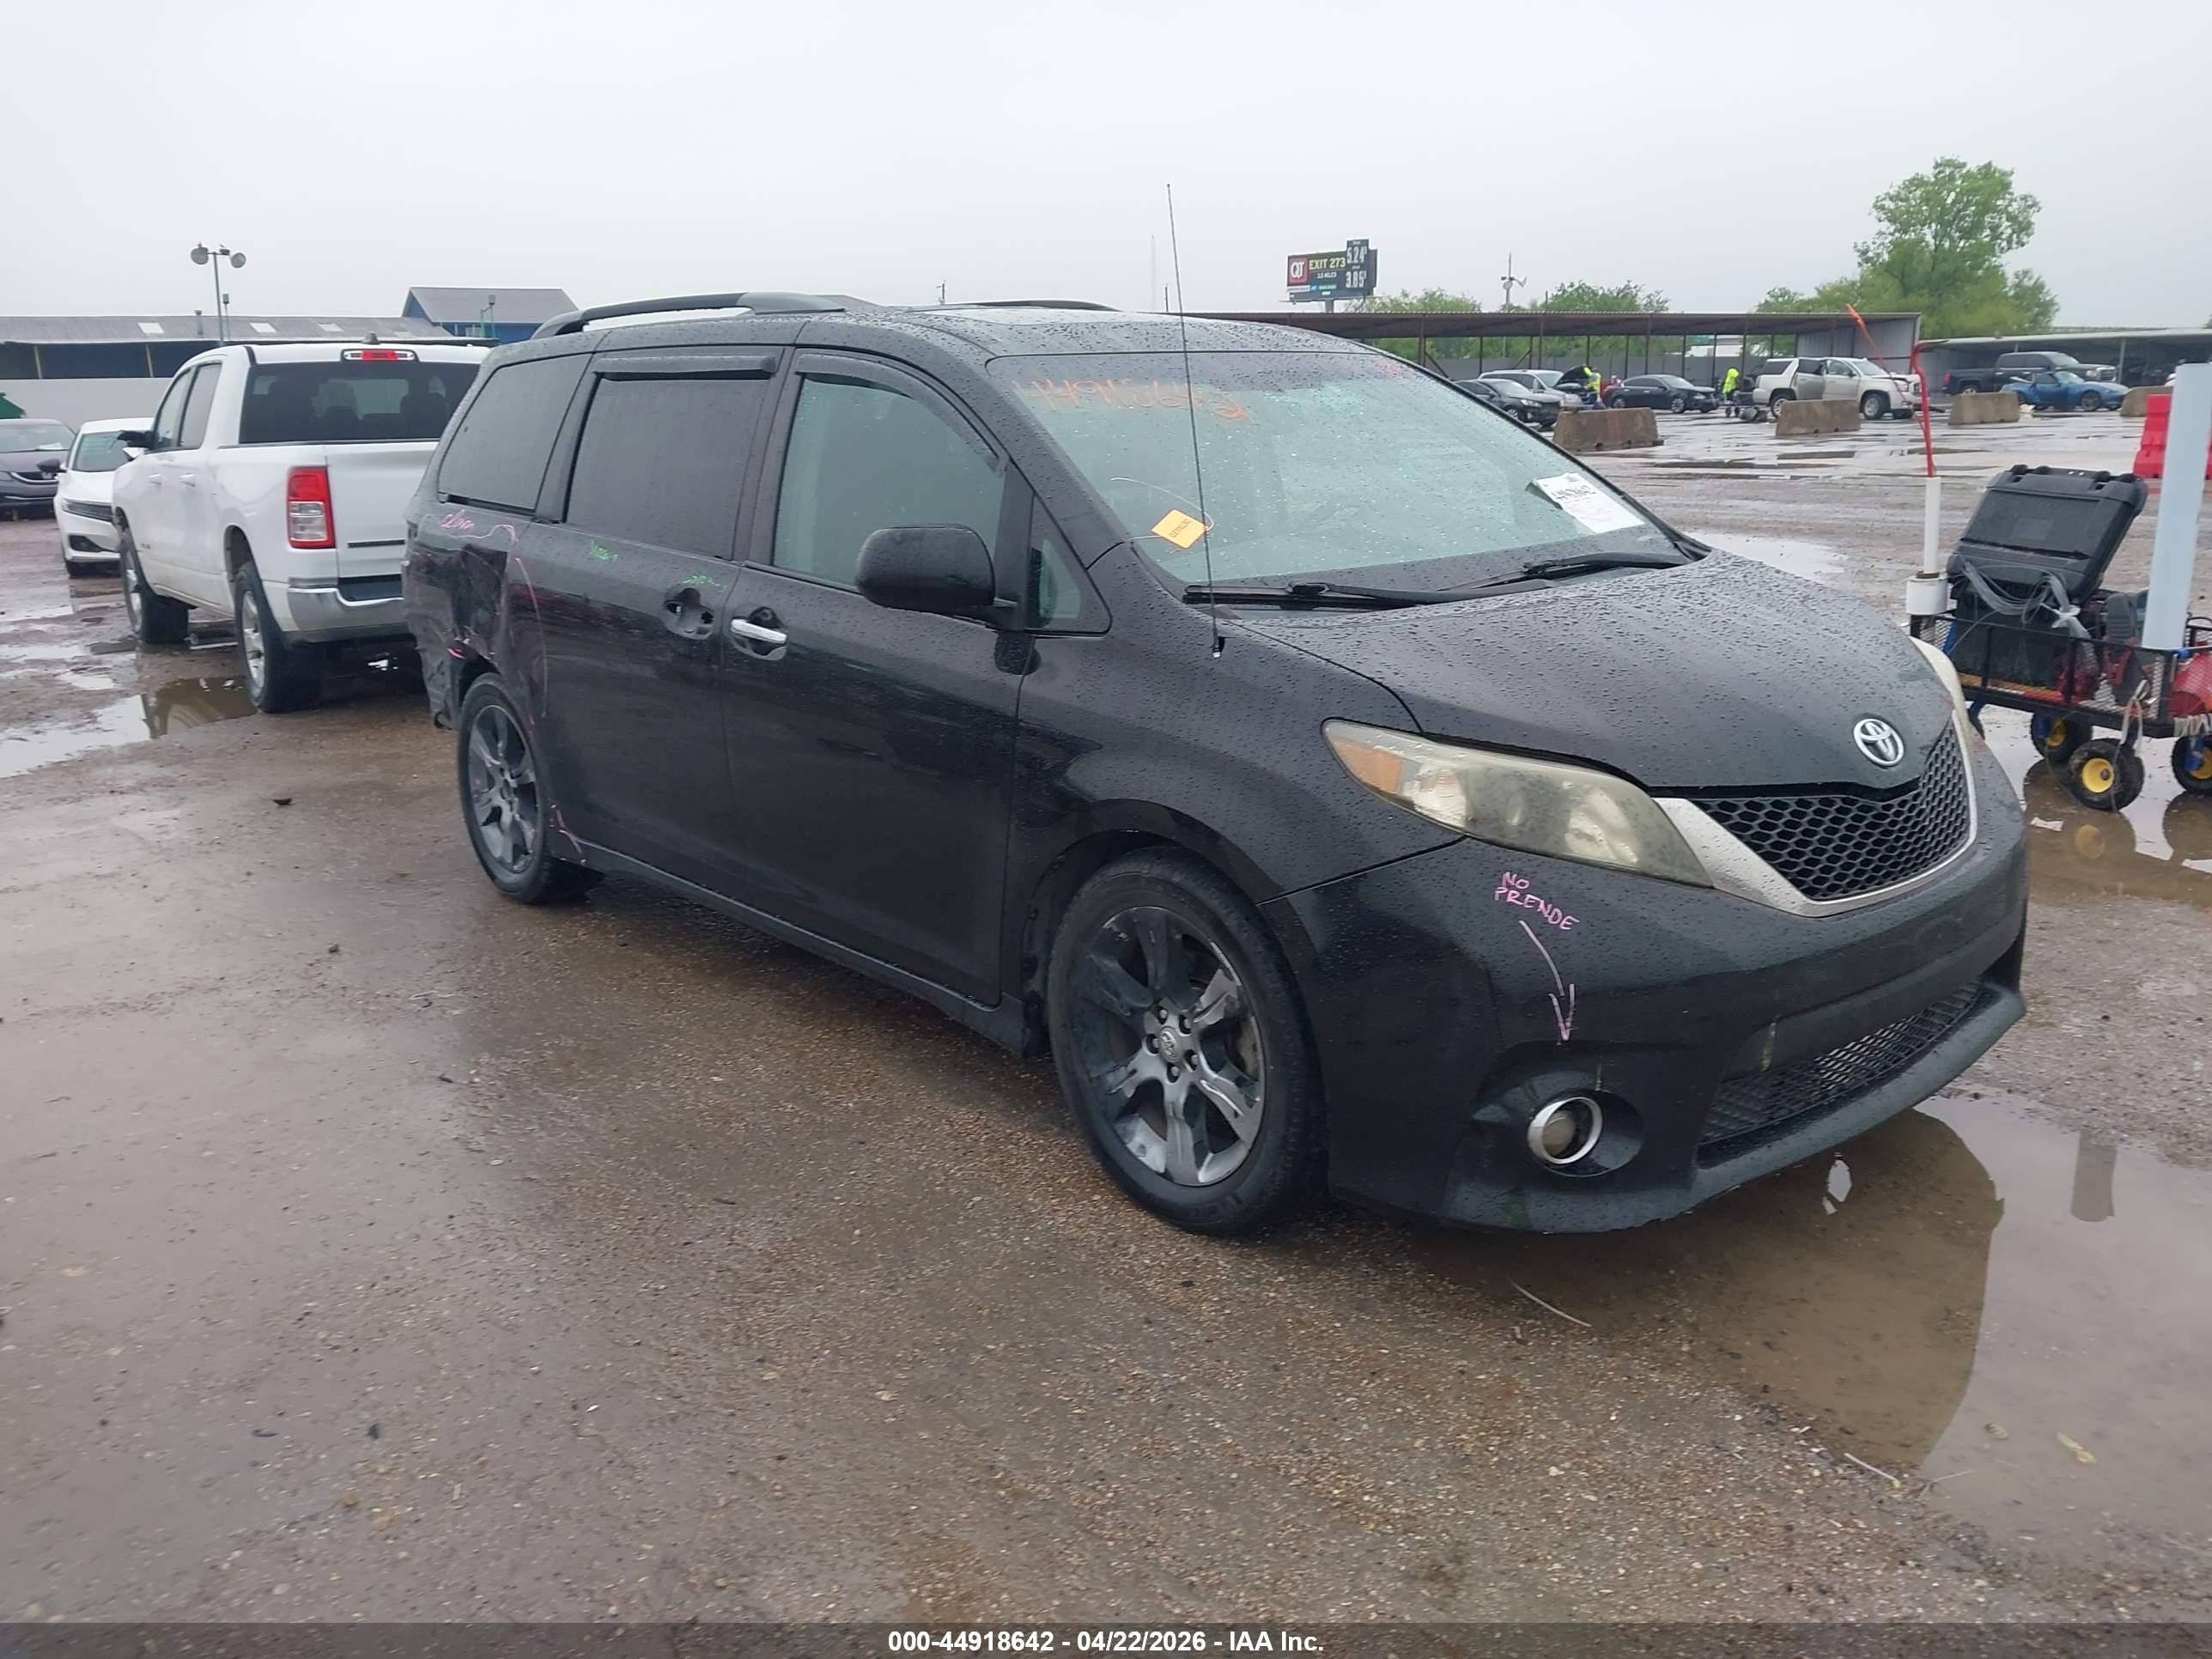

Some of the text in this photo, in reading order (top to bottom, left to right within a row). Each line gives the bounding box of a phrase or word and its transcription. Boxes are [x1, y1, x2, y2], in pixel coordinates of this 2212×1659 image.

[1291, 260, 1304, 278] QT
[1309, 257, 1346, 270] EXIT 273
[1502, 871, 1529, 890] NO
[1494, 886, 1580, 930] PRENDE
